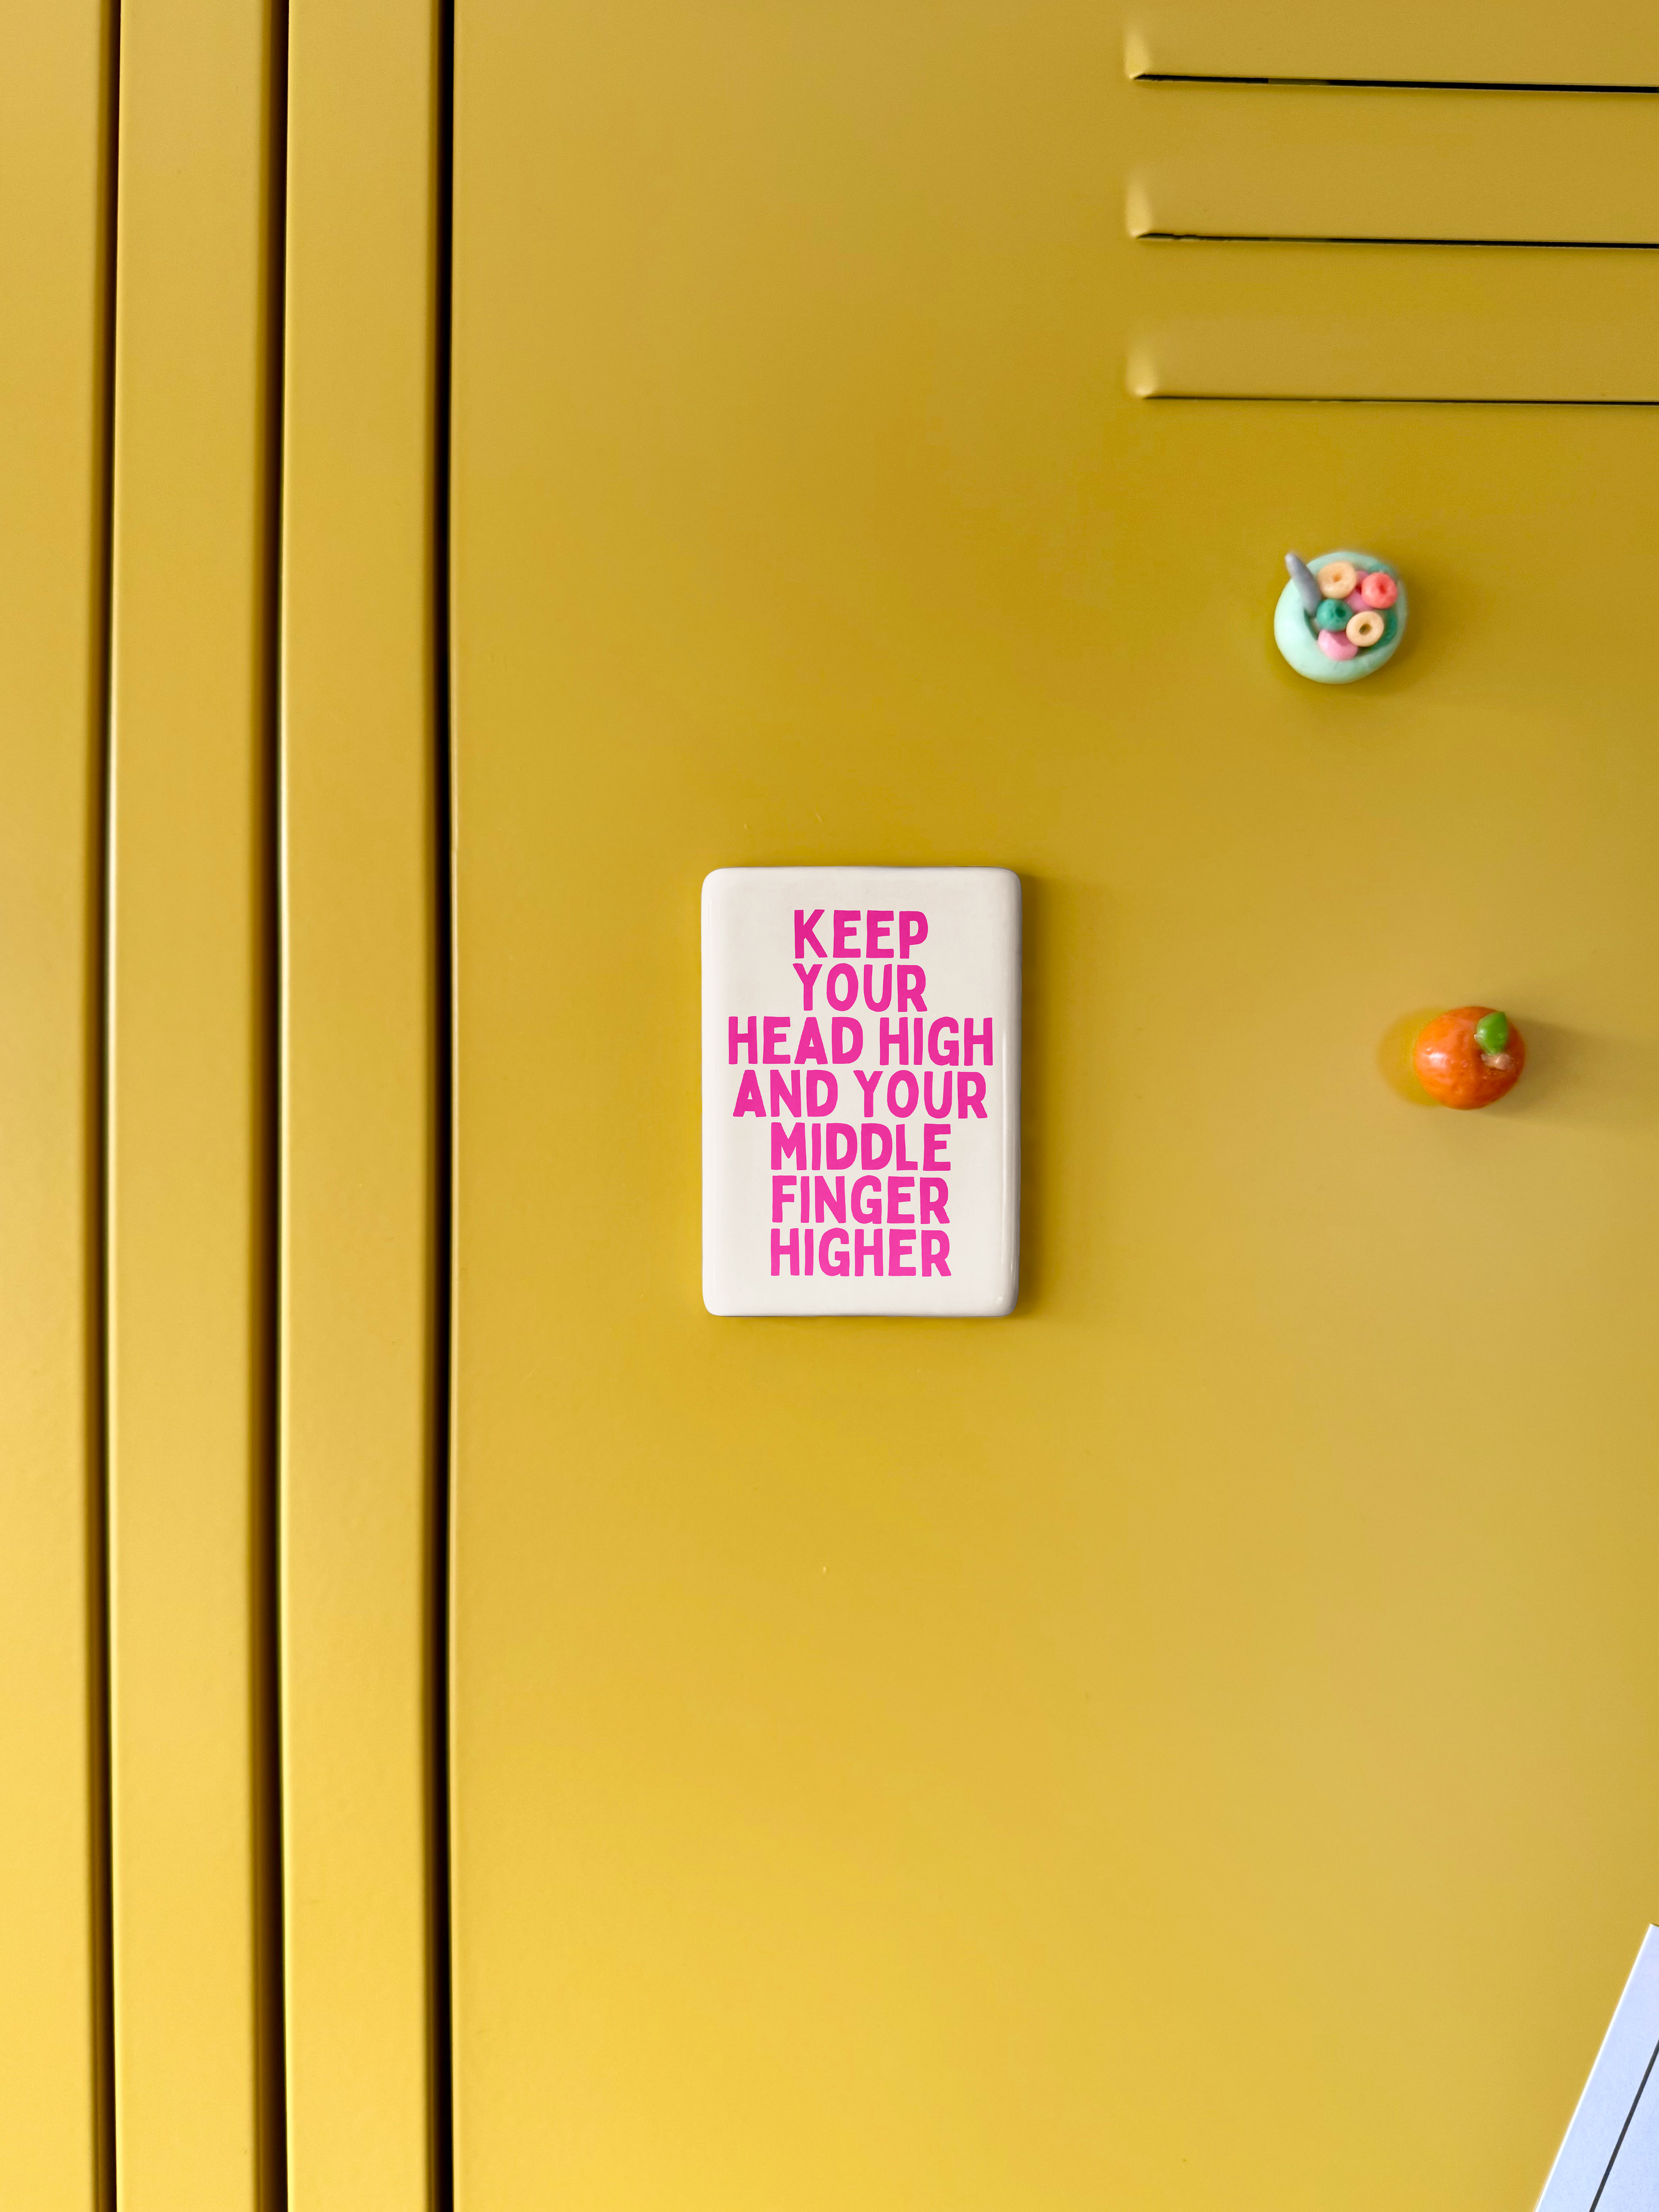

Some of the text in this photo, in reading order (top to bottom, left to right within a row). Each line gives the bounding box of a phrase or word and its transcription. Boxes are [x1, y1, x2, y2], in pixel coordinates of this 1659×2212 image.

[794, 909, 928, 959] KEEP
[793, 963, 927, 1012] YOUR
[728, 1016, 993, 1066] HEAD HIGH
[733, 1069, 988, 1119] AND YOUR
[771, 1122, 951, 1171] MIDDLE
[772, 1175, 950, 1224] FINGER
[771, 1228, 951, 1277] HIGHER
